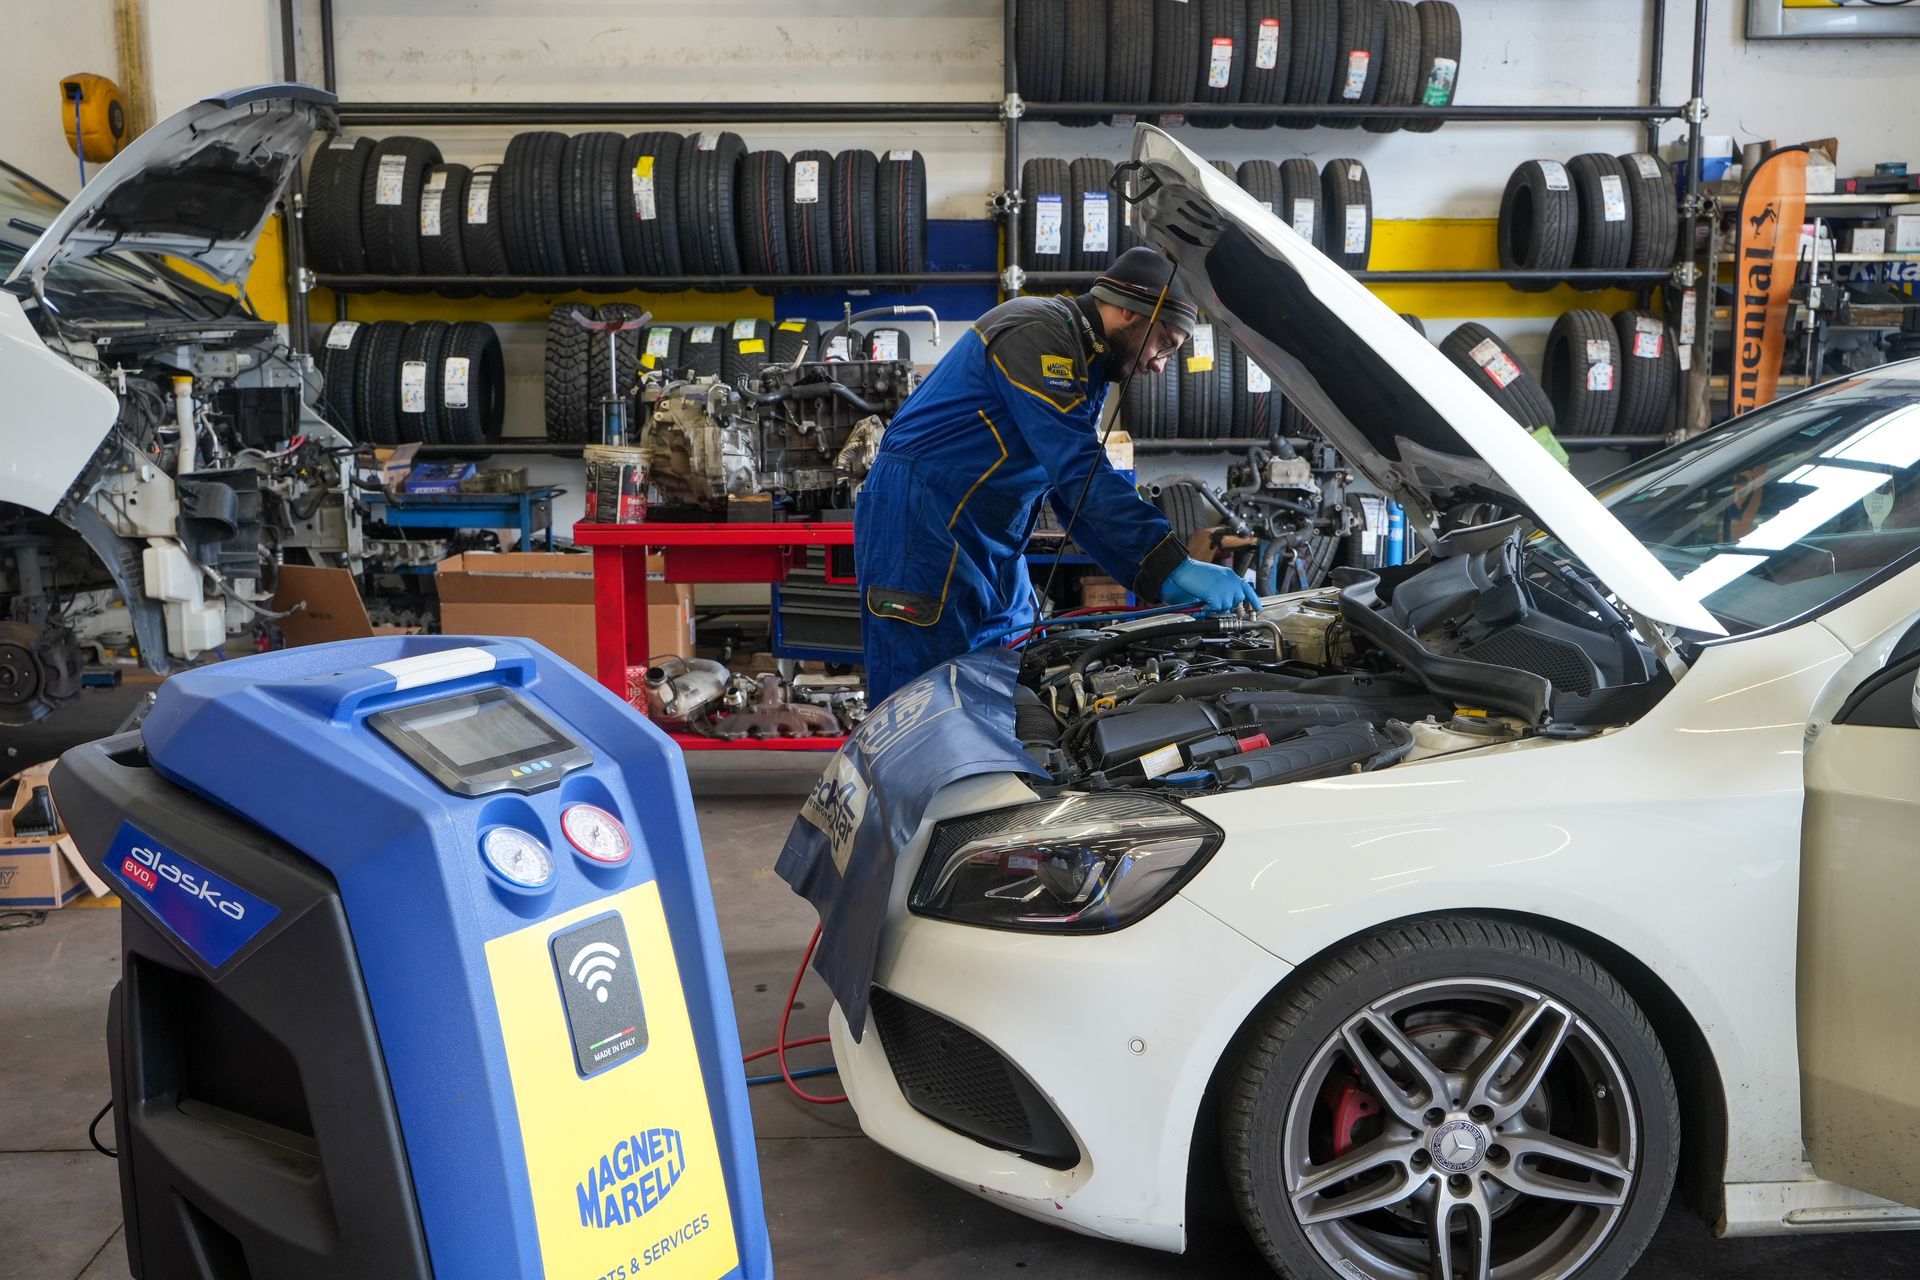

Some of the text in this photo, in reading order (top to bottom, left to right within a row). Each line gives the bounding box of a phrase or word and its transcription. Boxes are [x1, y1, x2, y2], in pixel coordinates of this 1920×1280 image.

[131, 847, 245, 920] alaska
[594, 1036, 636, 1062] MADE IN ITALY
[576, 1128, 685, 1208] MAGNETI
[577, 1156, 685, 1228] MARELLI
[630, 1257, 640, 1275] &
[643, 1213, 710, 1266] SERVICES
